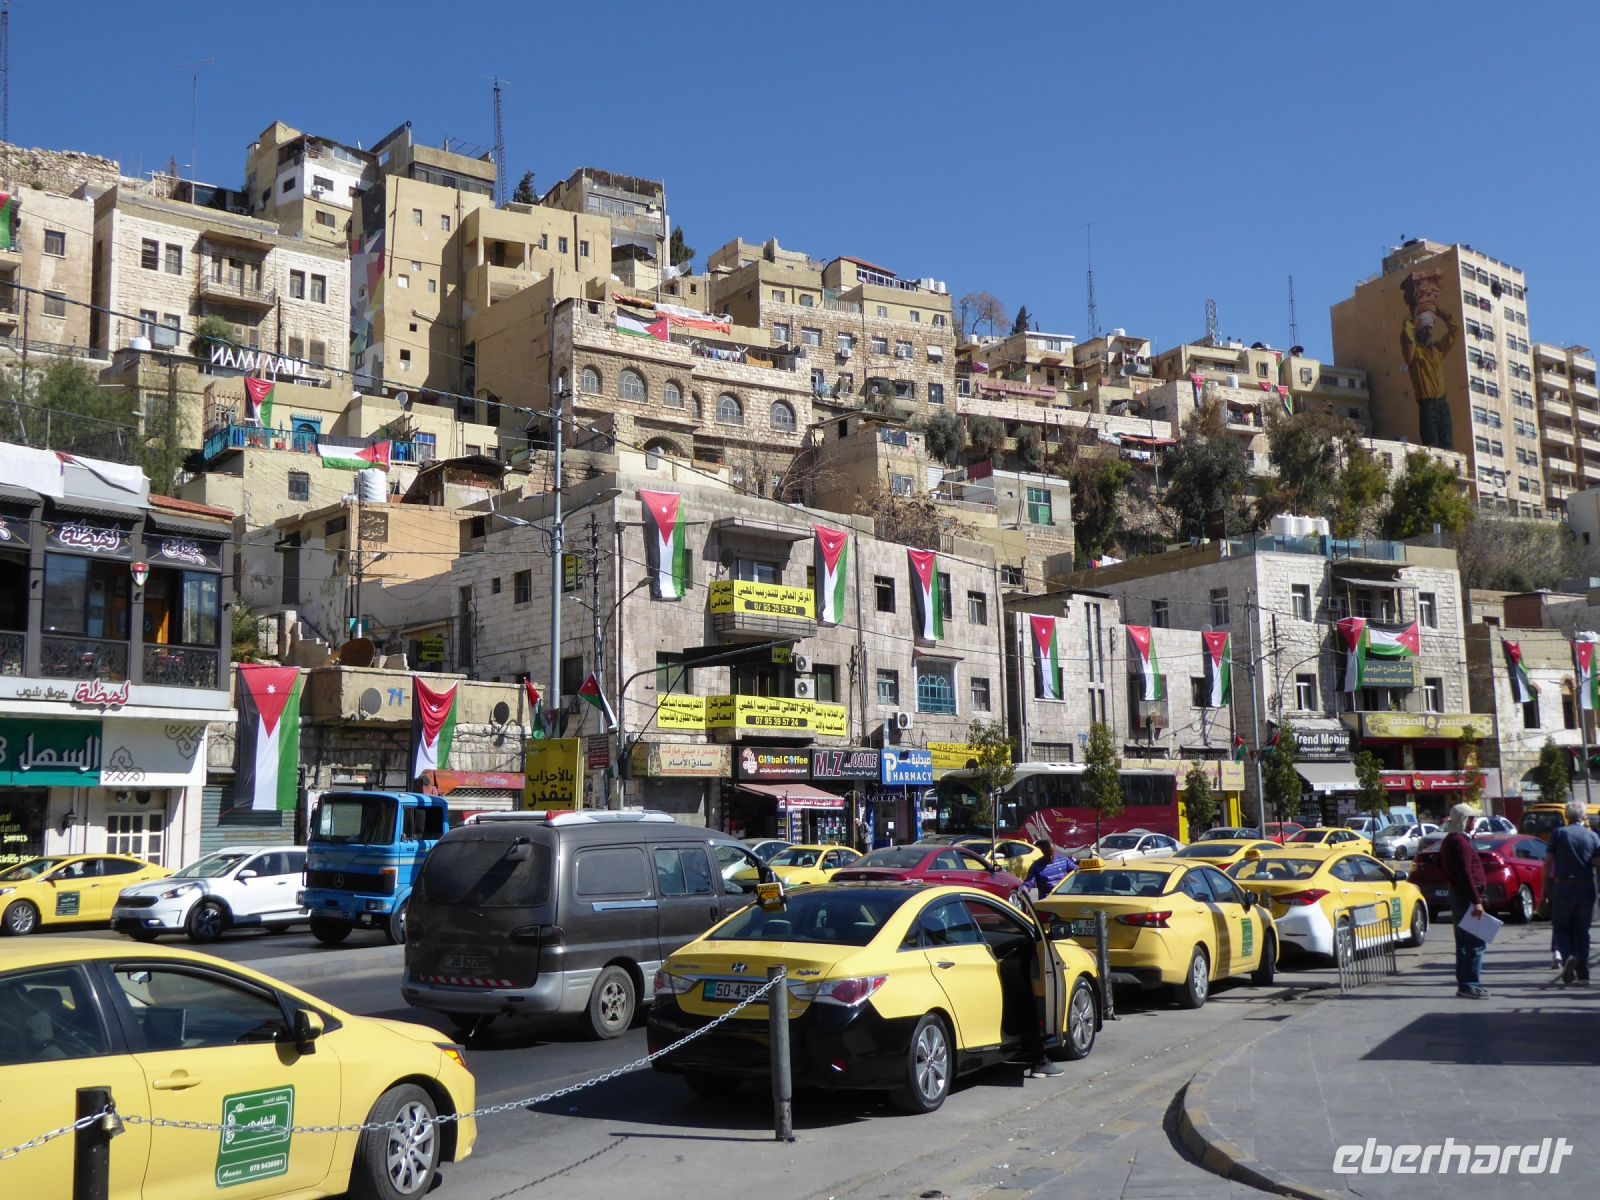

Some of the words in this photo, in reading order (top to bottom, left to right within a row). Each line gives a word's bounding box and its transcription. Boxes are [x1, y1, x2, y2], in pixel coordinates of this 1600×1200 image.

[16, 686, 41, 698] شوب
[75, 678, 131, 705] لحظة
[755, 716, 763, 725] 07
[773, 717, 781, 726] 39
[790, 718, 799, 727] 24
[1293, 733, 1319, 744] Trend
[19, 732, 100, 772] السهل
[758, 755, 783, 765] Global
[785, 755, 809, 765] Coffee
[883, 752, 932, 782] PHARMACY
[911, 753, 932, 768] صيدلية
[527, 769, 574, 785] بالأحزاب
[527, 785, 573, 807] بتقدر
